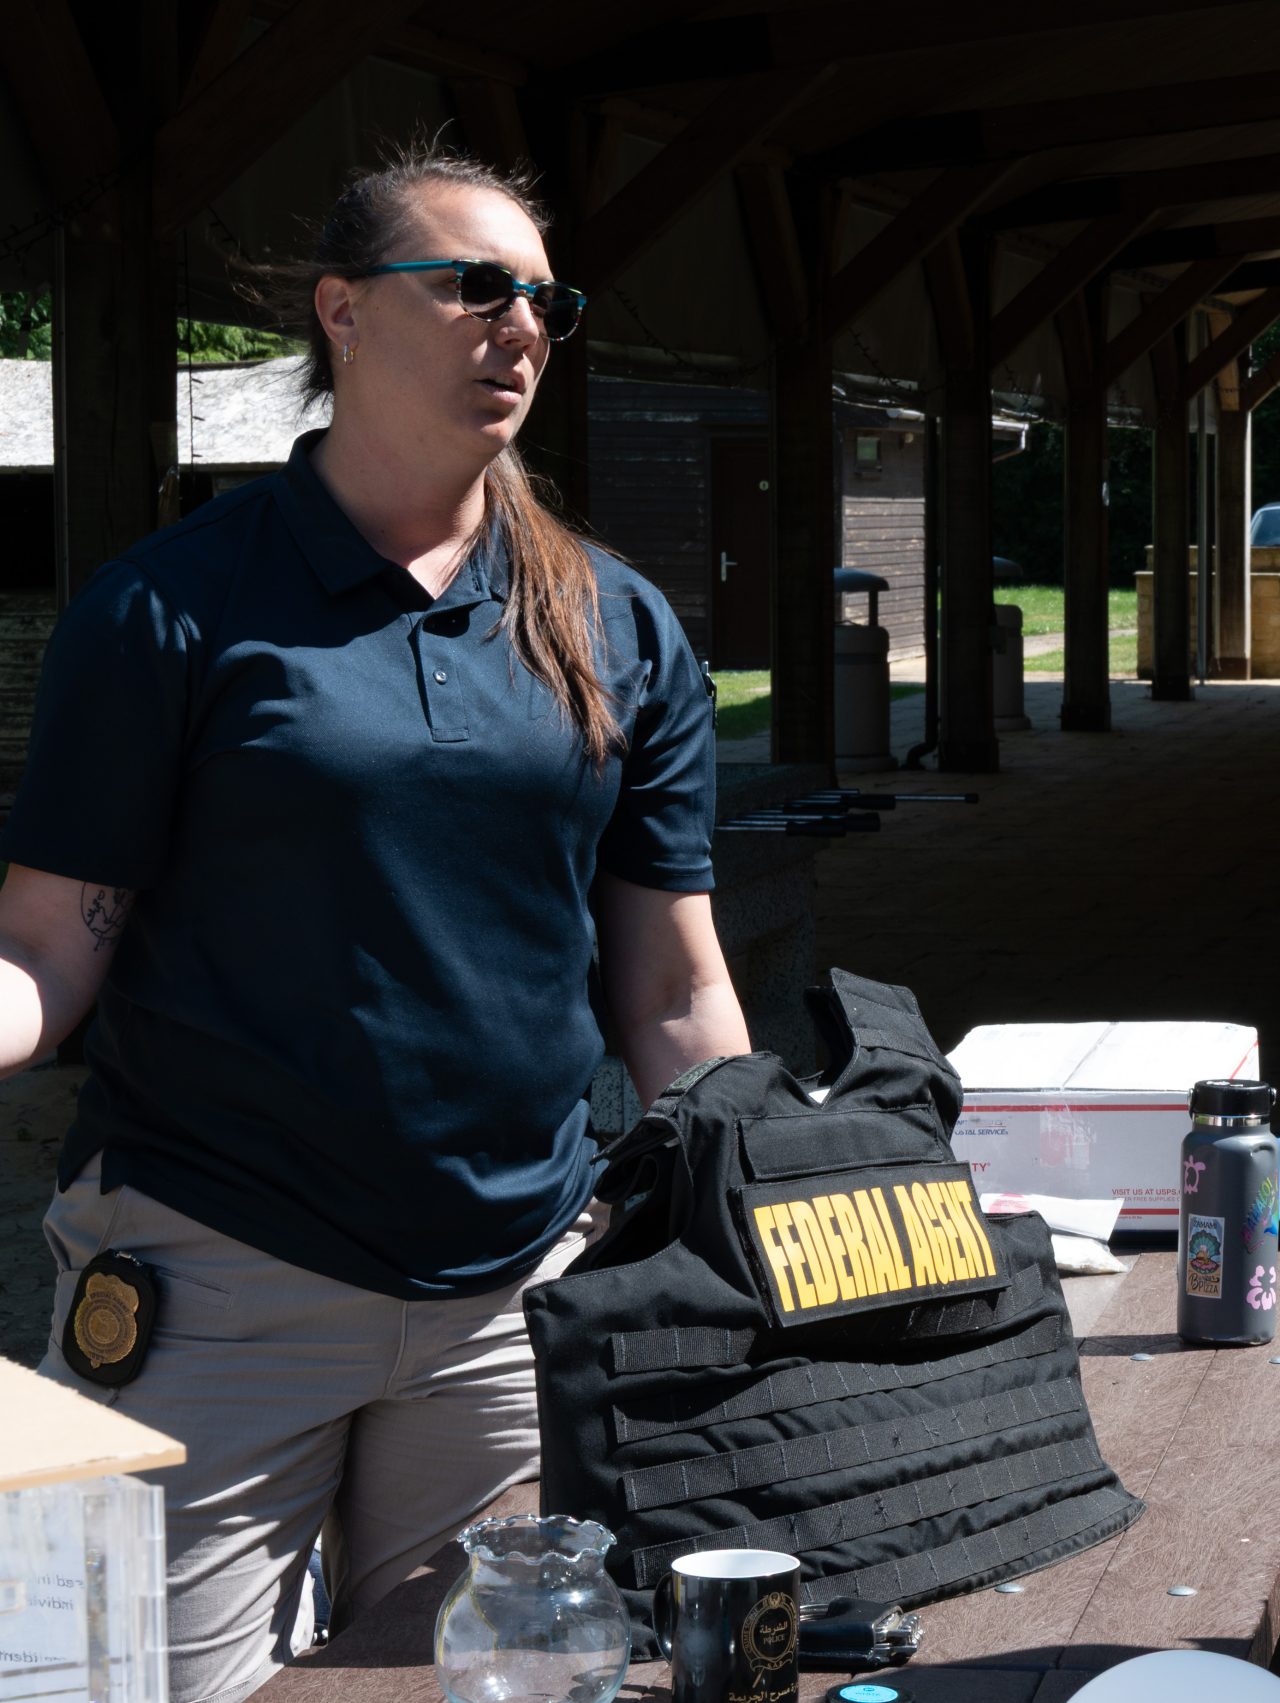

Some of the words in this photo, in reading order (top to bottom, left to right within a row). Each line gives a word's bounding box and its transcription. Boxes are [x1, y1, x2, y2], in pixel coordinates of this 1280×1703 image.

[1112, 1188, 1130, 1196] VISIT
[1132, 1188, 1143, 1196] US
[1144, 1188, 1154, 1196] AT
[753, 1187, 912, 1312] FEDERAL
[893, 1180, 996, 1286] AGENT
[1198, 1280, 1219, 1295] PIZZA
